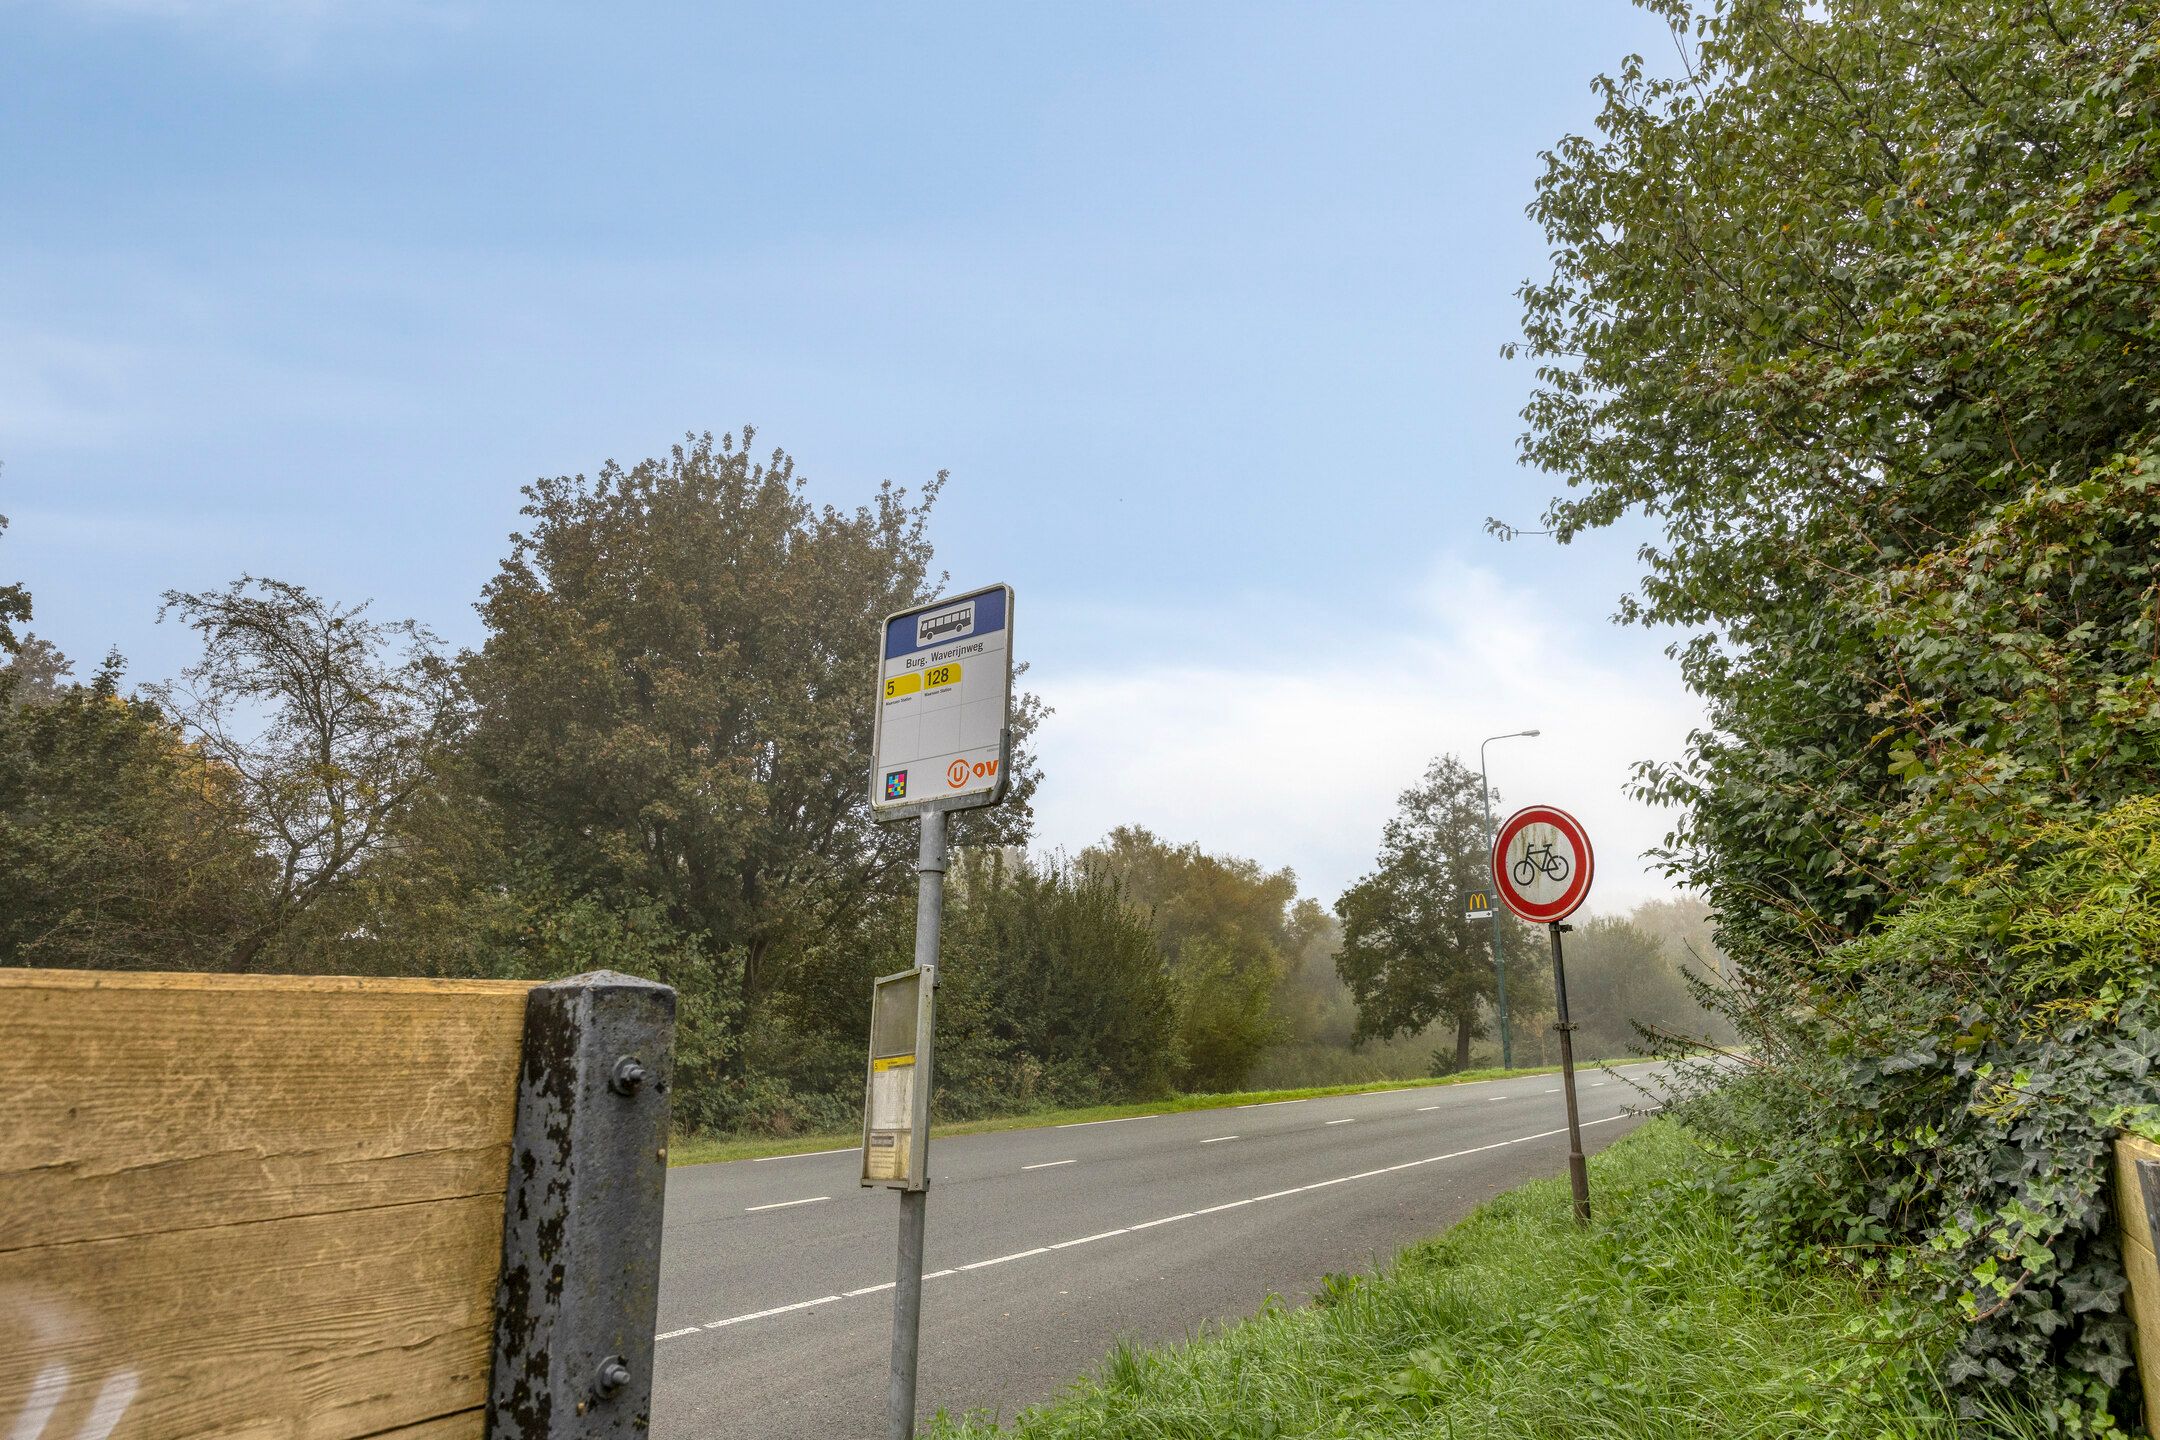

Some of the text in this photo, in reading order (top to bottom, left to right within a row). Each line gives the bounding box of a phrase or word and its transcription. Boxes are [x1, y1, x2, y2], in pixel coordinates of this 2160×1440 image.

[906, 642, 984, 669] Burg. Waverijnweg
[927, 668, 949, 686] 128
[886, 680, 895, 696] 5
[973, 760, 999, 778] OV
